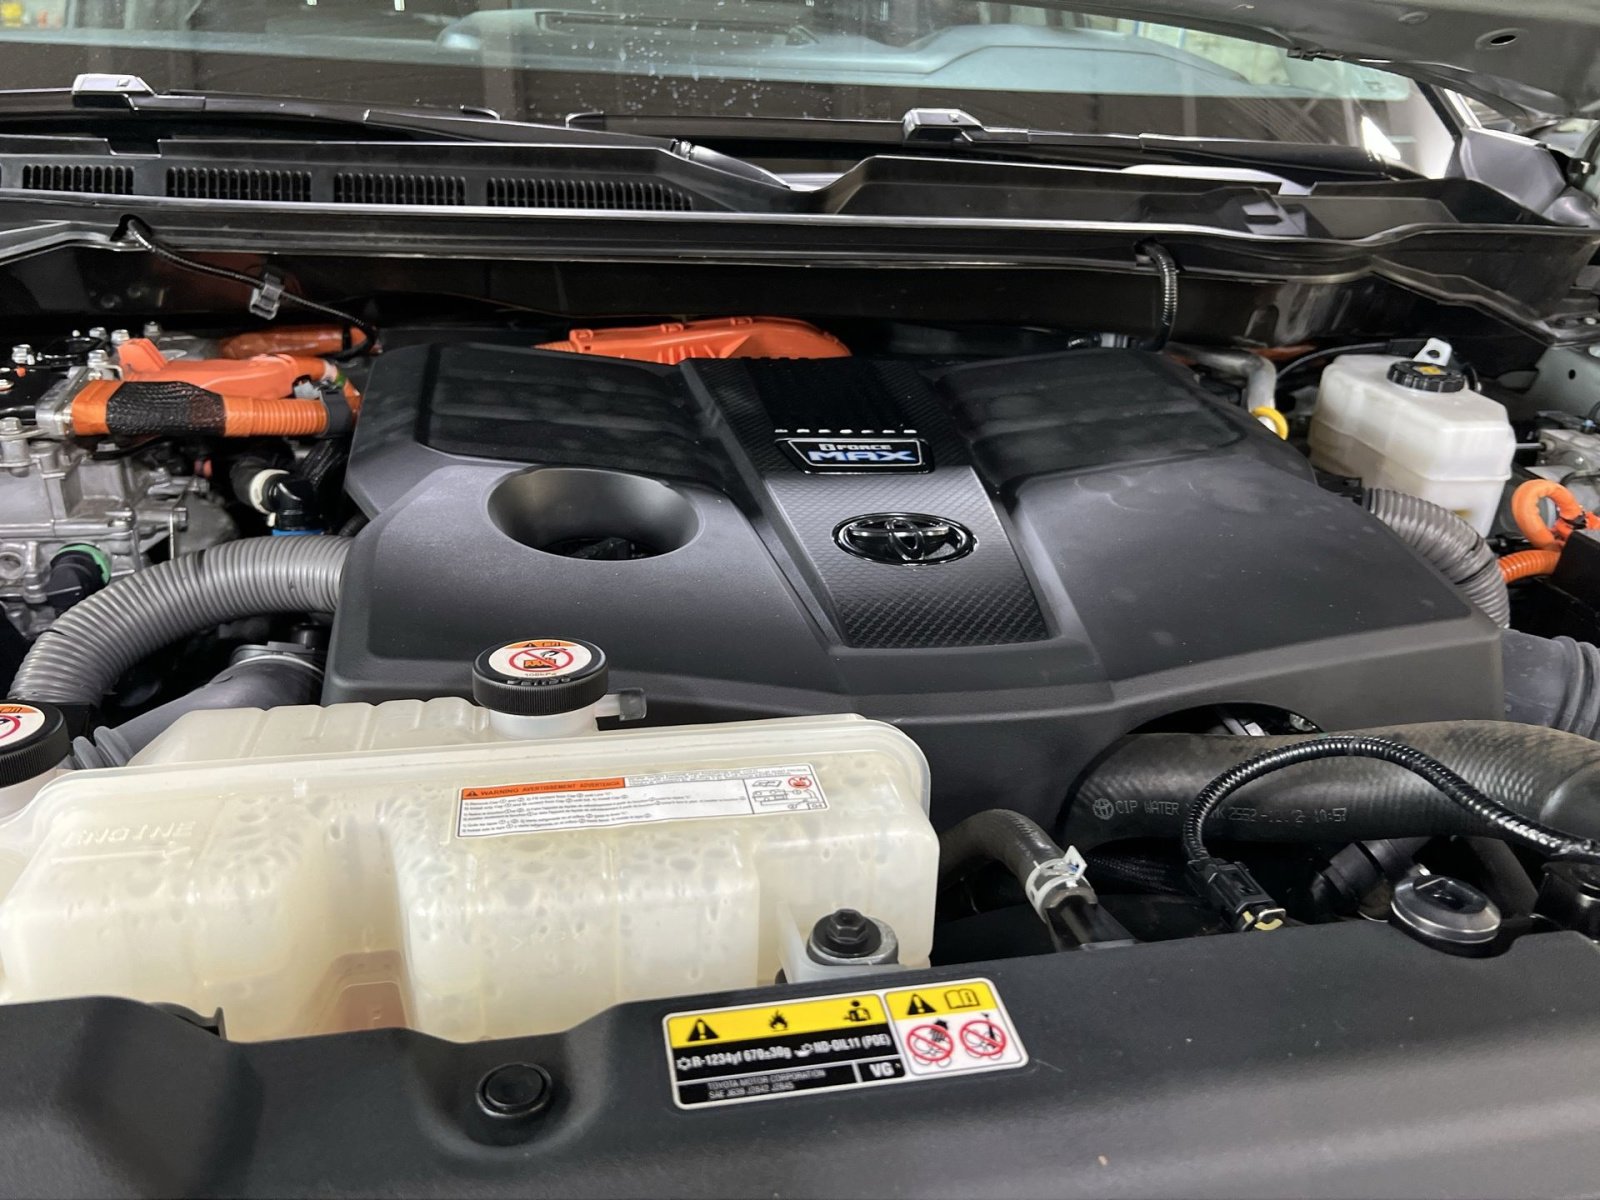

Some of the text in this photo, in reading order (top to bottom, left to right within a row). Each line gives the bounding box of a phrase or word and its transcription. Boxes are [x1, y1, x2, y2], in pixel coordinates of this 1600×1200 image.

[807, 451, 917, 461] MAX
[480, 788, 519, 796] WARNING
[1115, 800, 1138, 814] CIP
[1144, 801, 1180, 816] WATER
[861, 1033, 892, 1050] (POE)
[869, 1061, 895, 1078] VG
[707, 1069, 826, 1090] TOYOTA MOTOR CORPORATION
